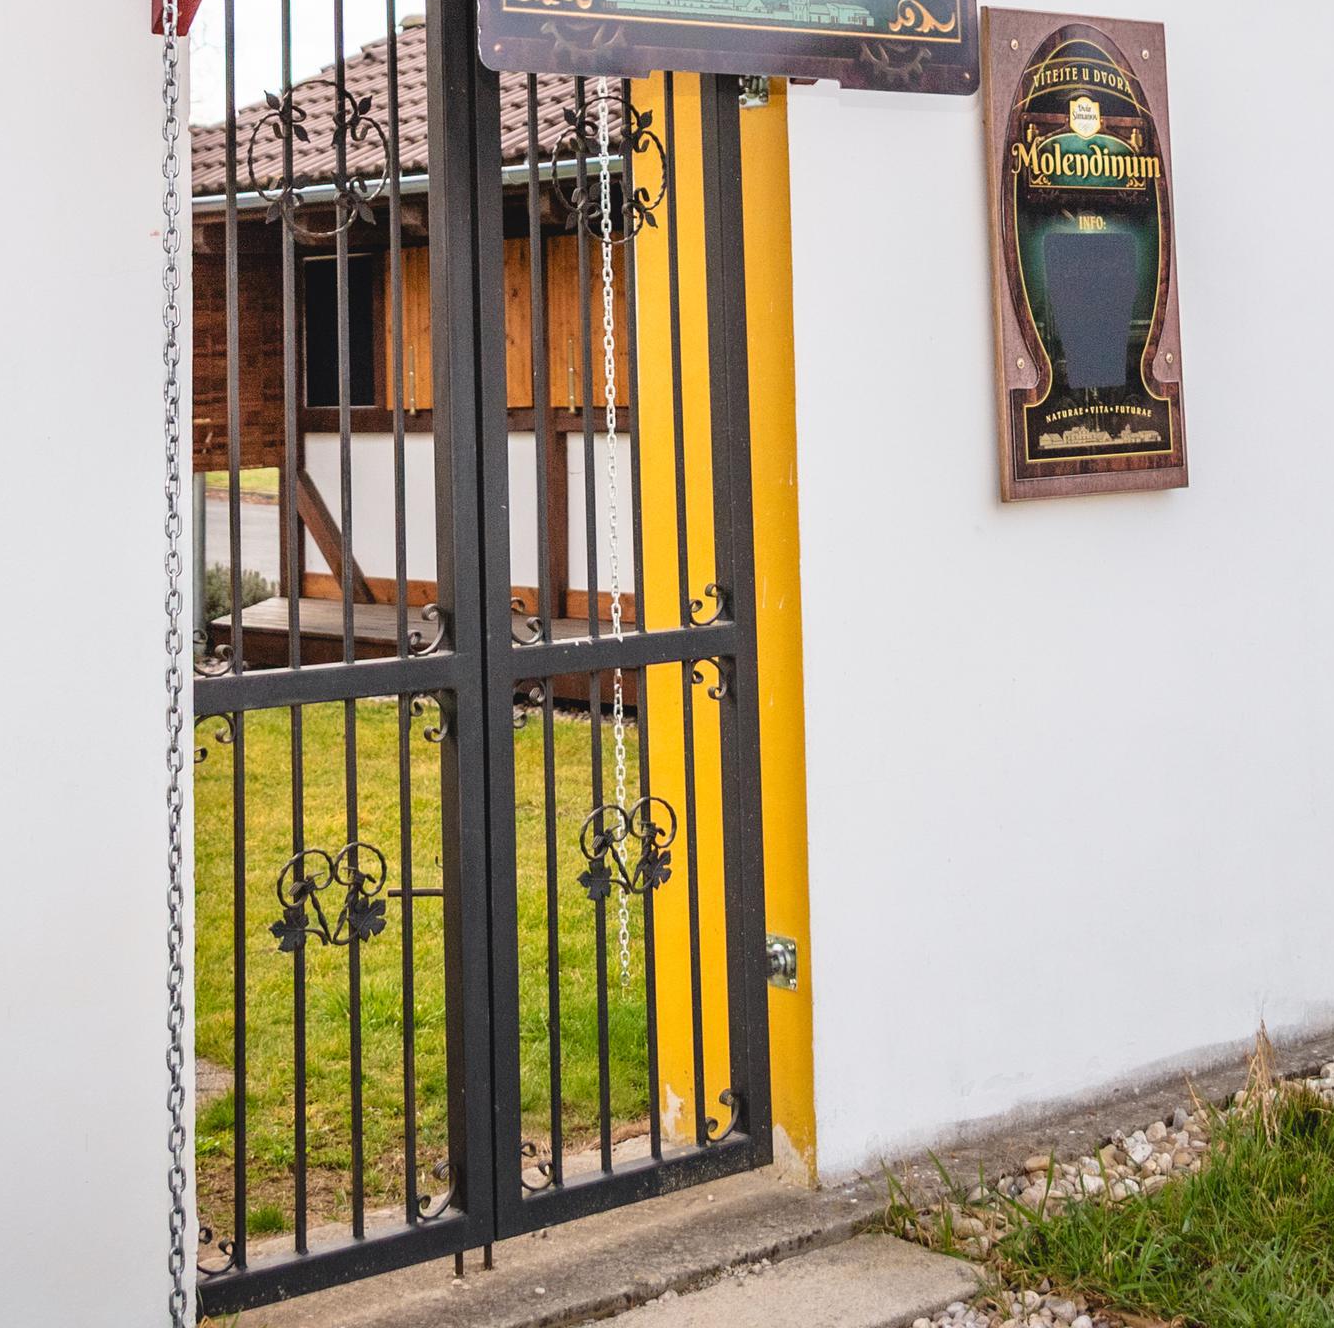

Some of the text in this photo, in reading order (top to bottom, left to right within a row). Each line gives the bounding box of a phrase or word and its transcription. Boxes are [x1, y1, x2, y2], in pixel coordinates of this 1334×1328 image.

[1082, 67, 1089, 81] U
[1093, 69, 1132, 94] DVORA
[1011, 136, 1161, 180] Molendinum
[1079, 215, 1107, 230] INFO:
[1045, 405, 1152, 423] NATURAE VITA FUTURAE
